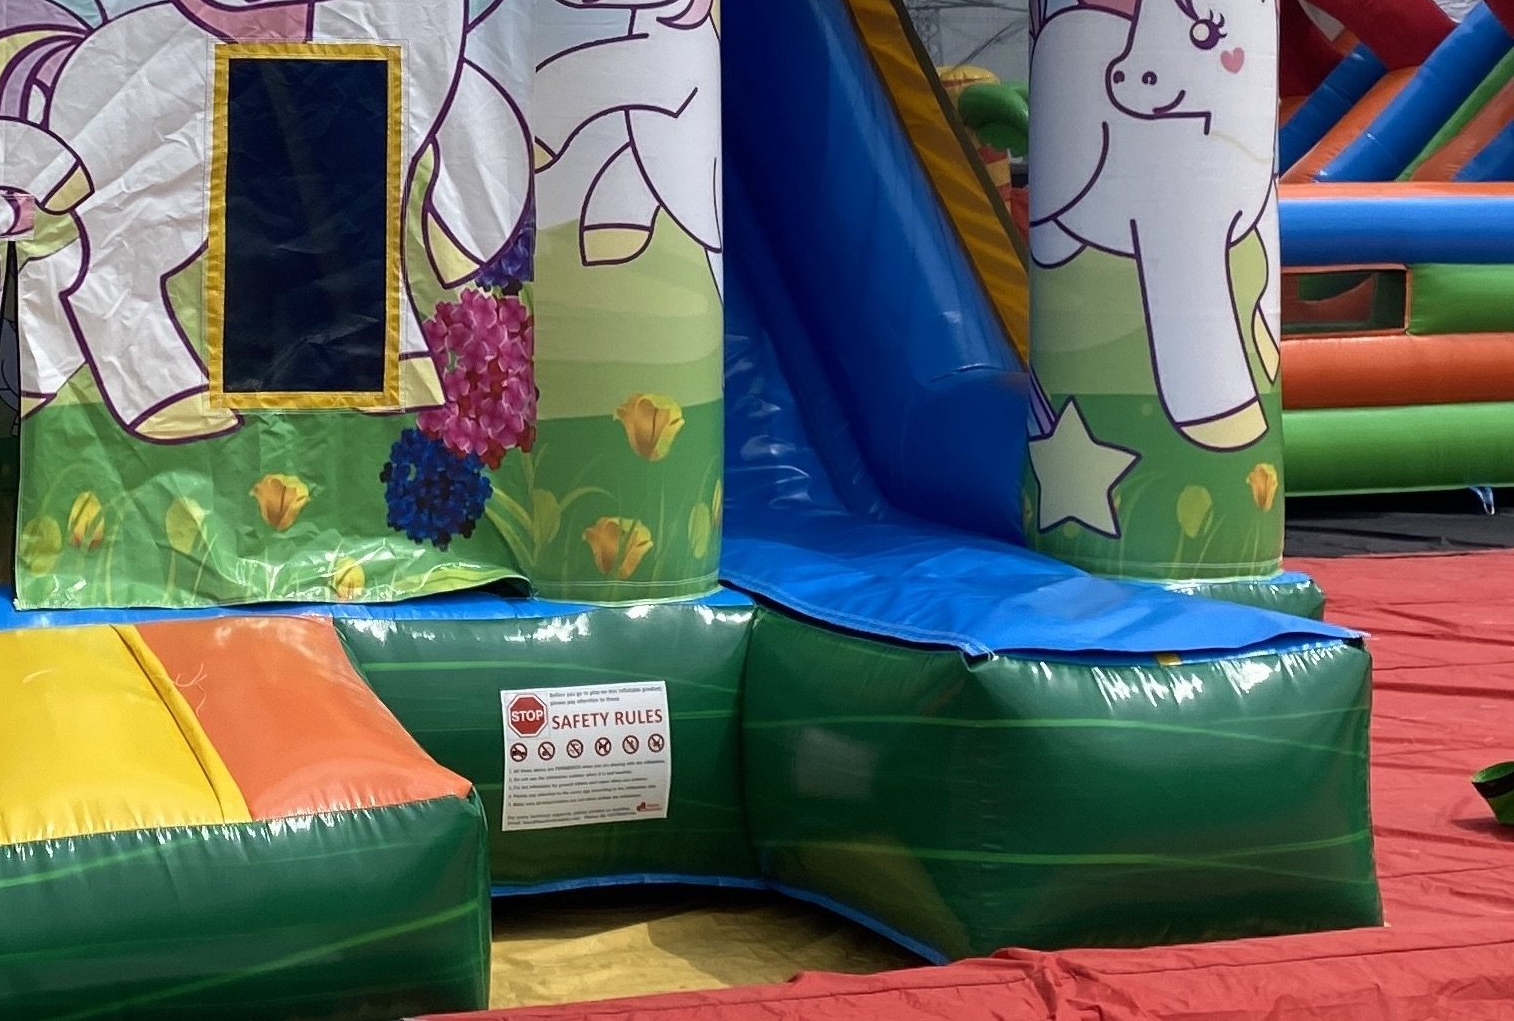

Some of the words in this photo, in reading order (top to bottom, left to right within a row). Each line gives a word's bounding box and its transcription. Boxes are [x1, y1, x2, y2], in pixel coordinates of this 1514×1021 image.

[511, 711, 543, 722] STOP
[551, 711, 609, 730] SAFETY
[614, 708, 663, 726] RULES
